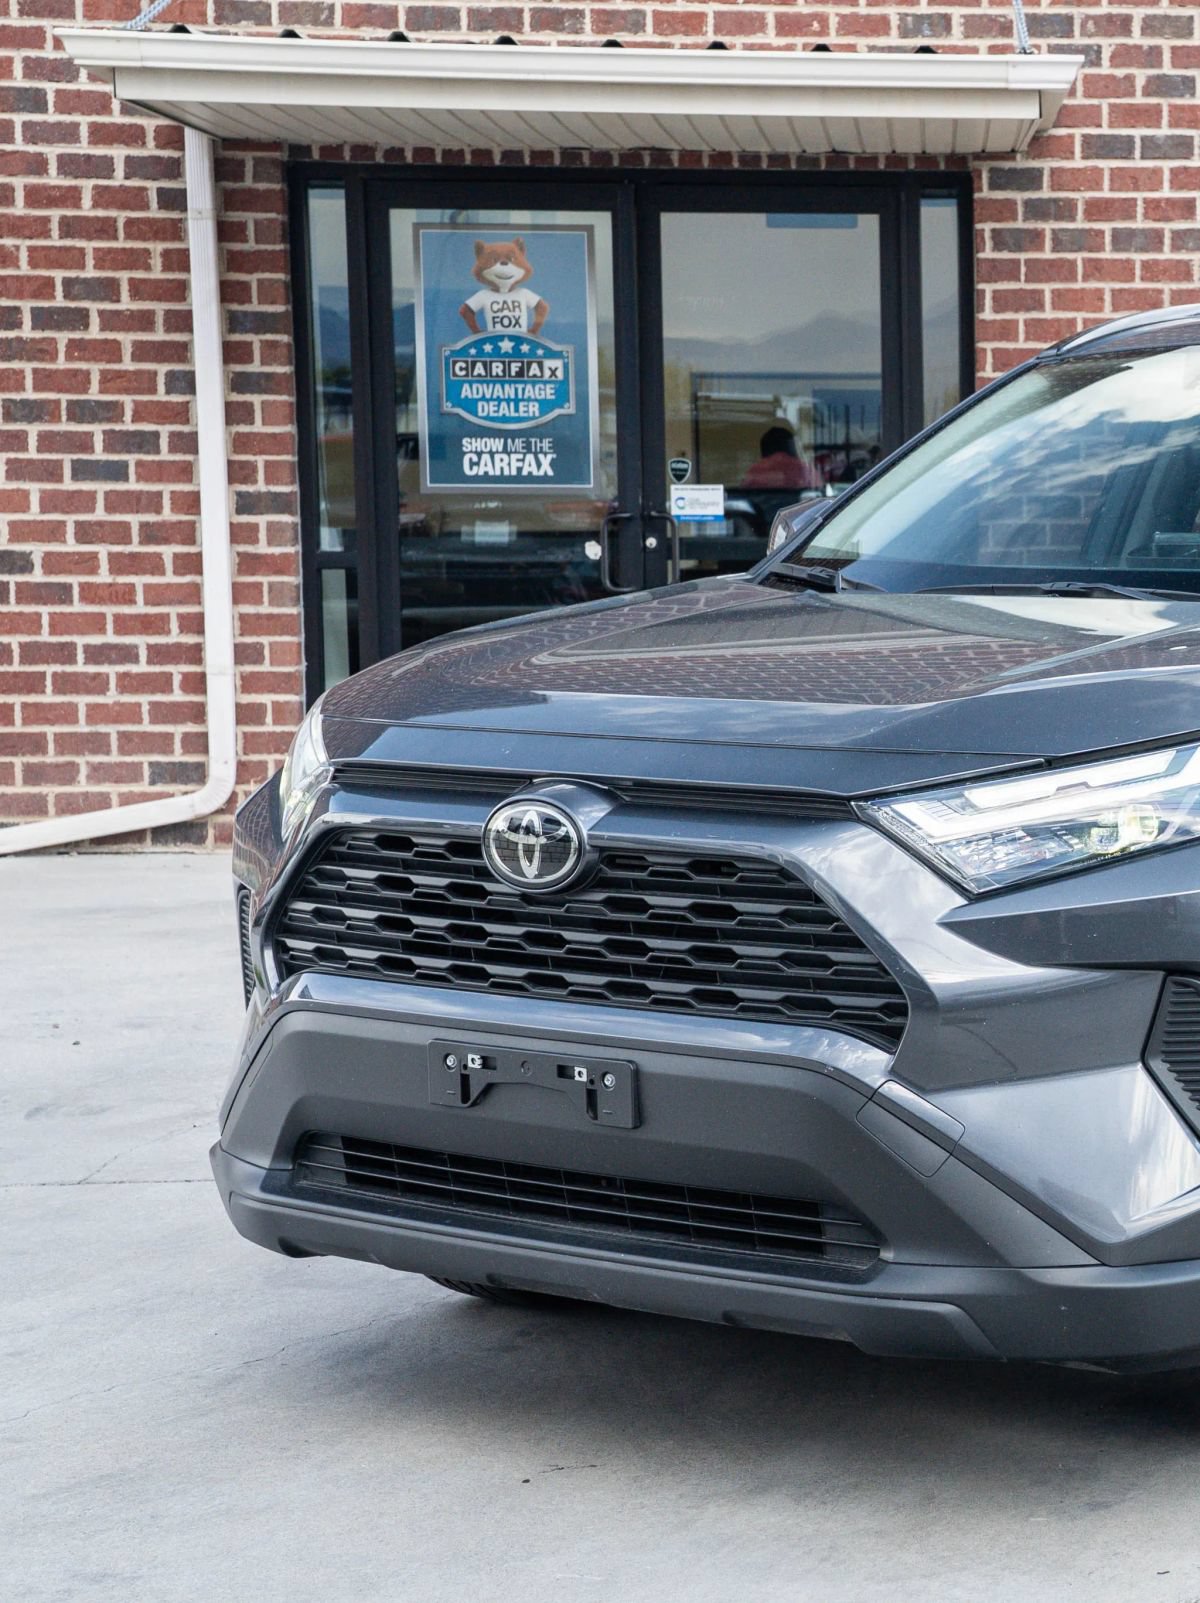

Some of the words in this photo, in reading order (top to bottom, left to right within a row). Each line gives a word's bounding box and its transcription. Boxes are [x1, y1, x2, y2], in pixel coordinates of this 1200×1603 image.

[490, 300, 522, 313] CAR
[491, 315, 522, 329] FOX
[453, 360, 562, 379] CARFAX
[460, 383, 556, 400] ADVANTAGE
[477, 401, 540, 417] DEALER
[462, 437, 504, 452] SHOW
[507, 438, 527, 452] ME
[529, 438, 554, 452] THE
[463, 453, 555, 476] CARFAX
